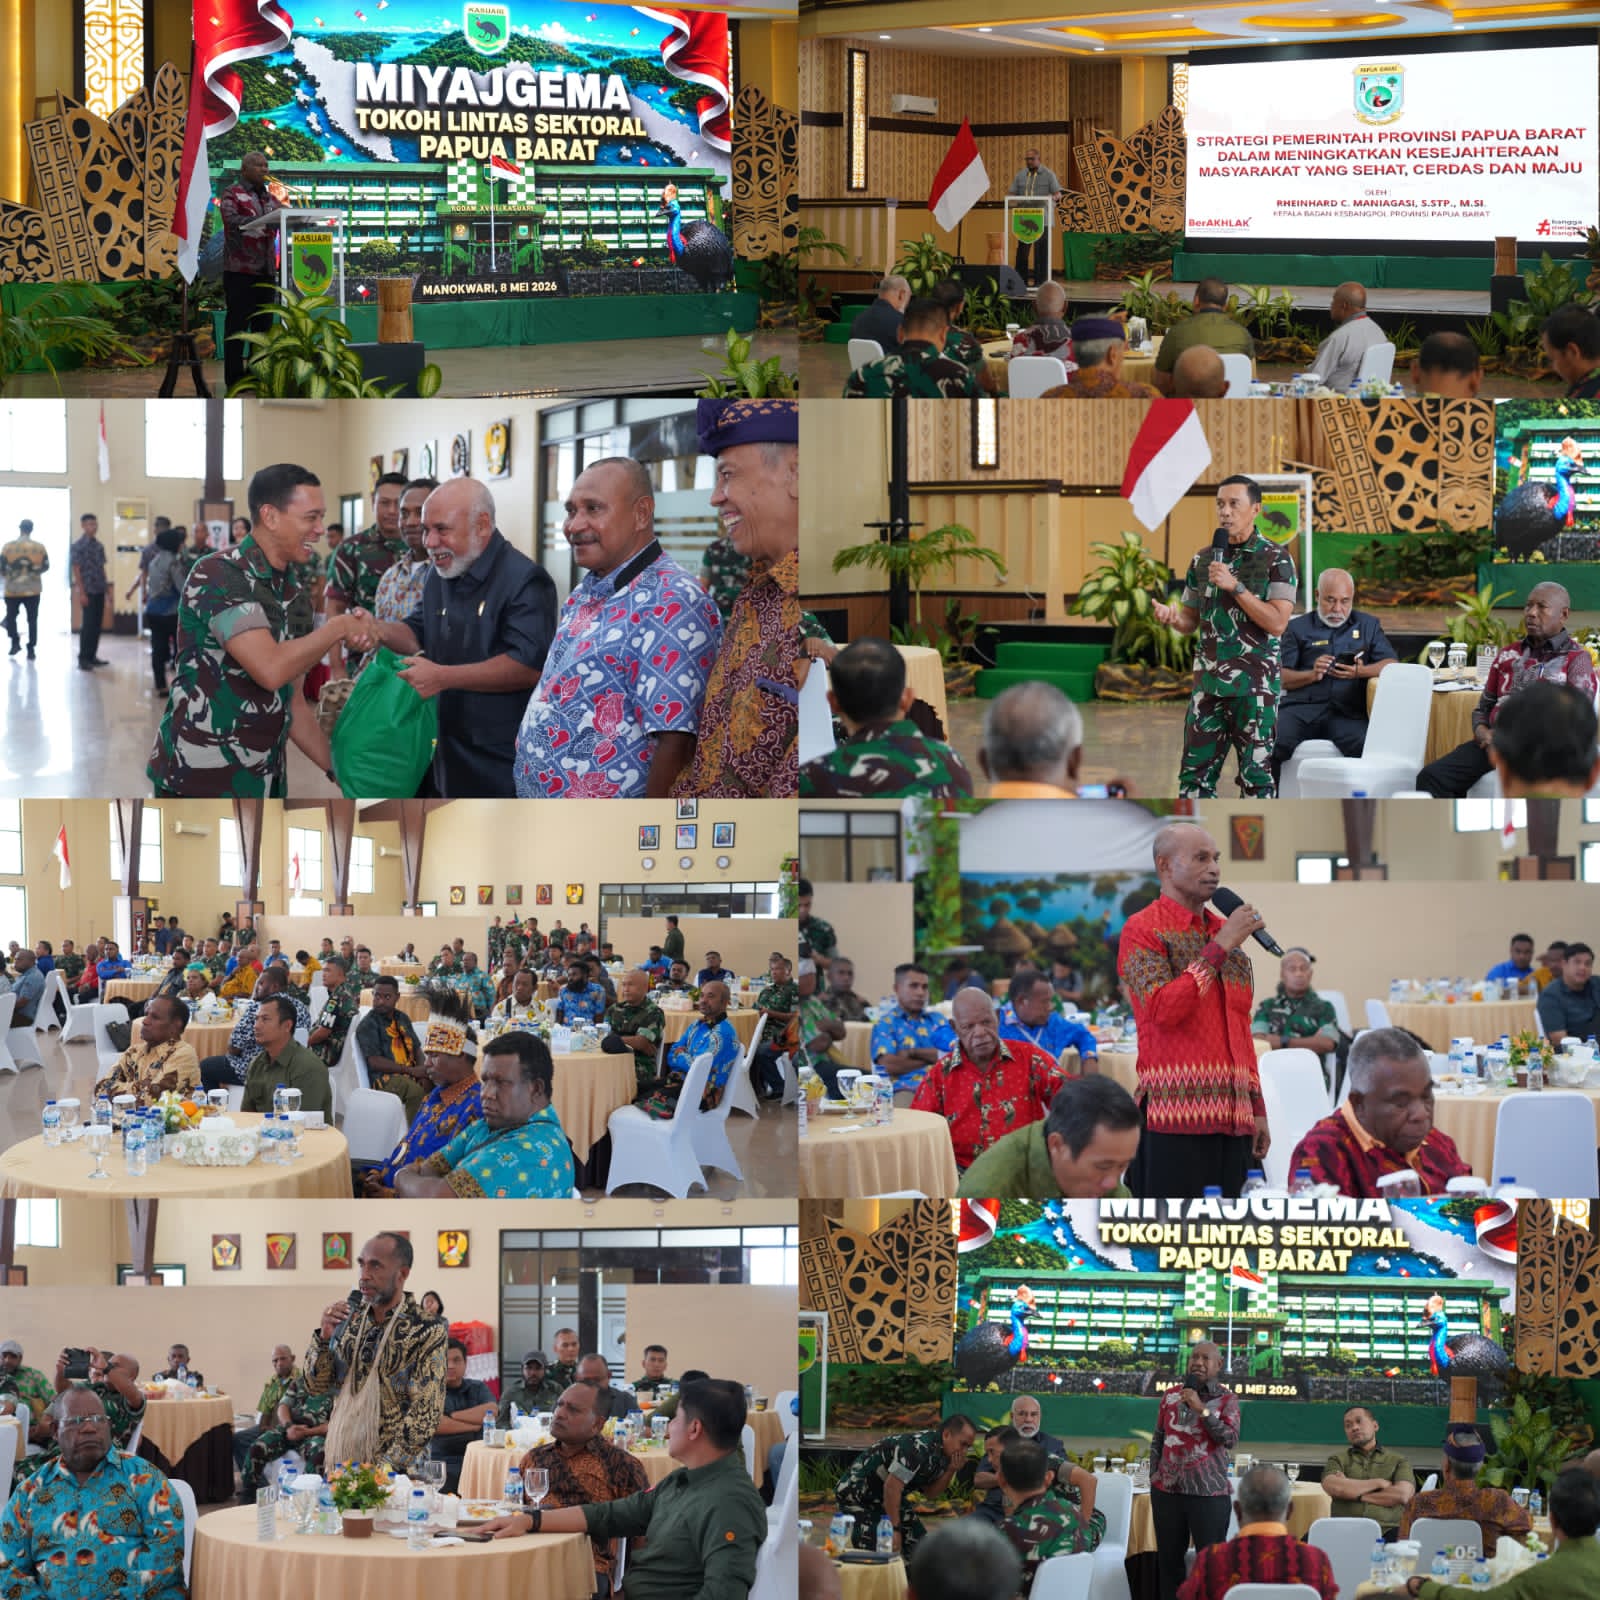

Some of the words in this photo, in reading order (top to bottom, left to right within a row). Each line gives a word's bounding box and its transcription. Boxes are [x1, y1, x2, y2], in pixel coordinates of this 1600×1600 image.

[356, 61, 631, 110] MIYAJGEMA
[355, 108, 441, 131] TOKOH
[449, 111, 529, 134] LINTAS
[534, 114, 647, 136] SEKTORAL
[1196, 135, 1269, 147] STRATEGI
[1273, 132, 1373, 145] PEMERINTAH
[1378, 130, 1456, 143] PROVINSI
[1462, 129, 1521, 141] PAPUA
[1525, 127, 1586, 140] BARAT
[420, 135, 508, 160] PAPUA
[515, 138, 600, 161] BARAT
[1218, 151, 1270, 162] DALAM
[1275, 148, 1401, 161] MENINGKATKAN
[1406, 145, 1559, 159] KESEJAHTERAAN
[1199, 166, 1301, 177] MASYARAKAT
[1305, 165, 1348, 176] YANG
[1352, 164, 1409, 176] SEHAT,
[1413, 163, 1484, 175] CERDAS
[1489, 163, 1528, 175] DAN
[1532, 162, 1583, 174] MAJU
[1353, 199, 1418, 208] MANIAGASI,
[1188, 218, 1249, 227] BerAKHLAK
[422, 283, 498, 295] MANOKWARI,
[500, 283, 507, 292] 8
[510, 282, 529, 292] MEI
[531, 281, 557, 292] 2026
[1098, 1222, 1182, 1243] TOKOH
[1187, 1224, 1274, 1246] LINTAS
[1279, 1225, 1410, 1248] SEKTORAL
[1159, 1246, 1251, 1271] PAPUA
[1258, 1248, 1352, 1273] BARAT
[1235, 1383, 1243, 1394] 8
[1246, 1384, 1266, 1394] MEI
[1269, 1385, 1298, 1395] 2026
